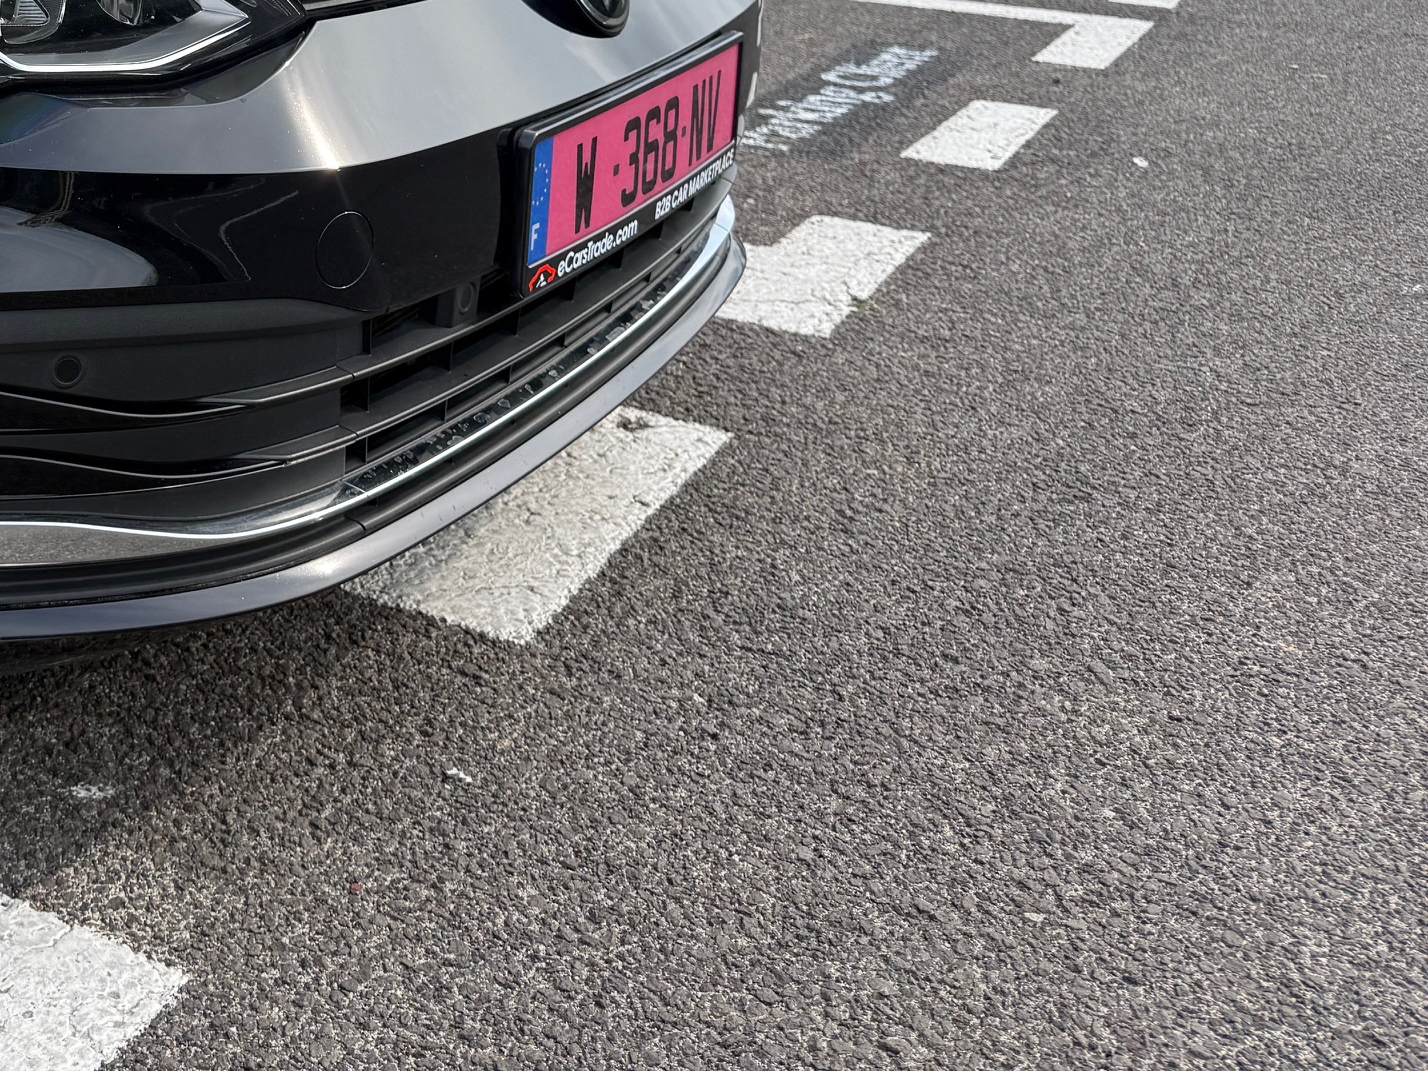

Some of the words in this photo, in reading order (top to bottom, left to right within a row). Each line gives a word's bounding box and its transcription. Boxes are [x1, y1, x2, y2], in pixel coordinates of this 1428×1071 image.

[654, 194, 672, 220] B2B
[672, 182, 689, 209] CAR
[688, 147, 735, 197] MARKETPLACE
[530, 222, 540, 251] F
[557, 218, 638, 277] eCarsTrade.com
